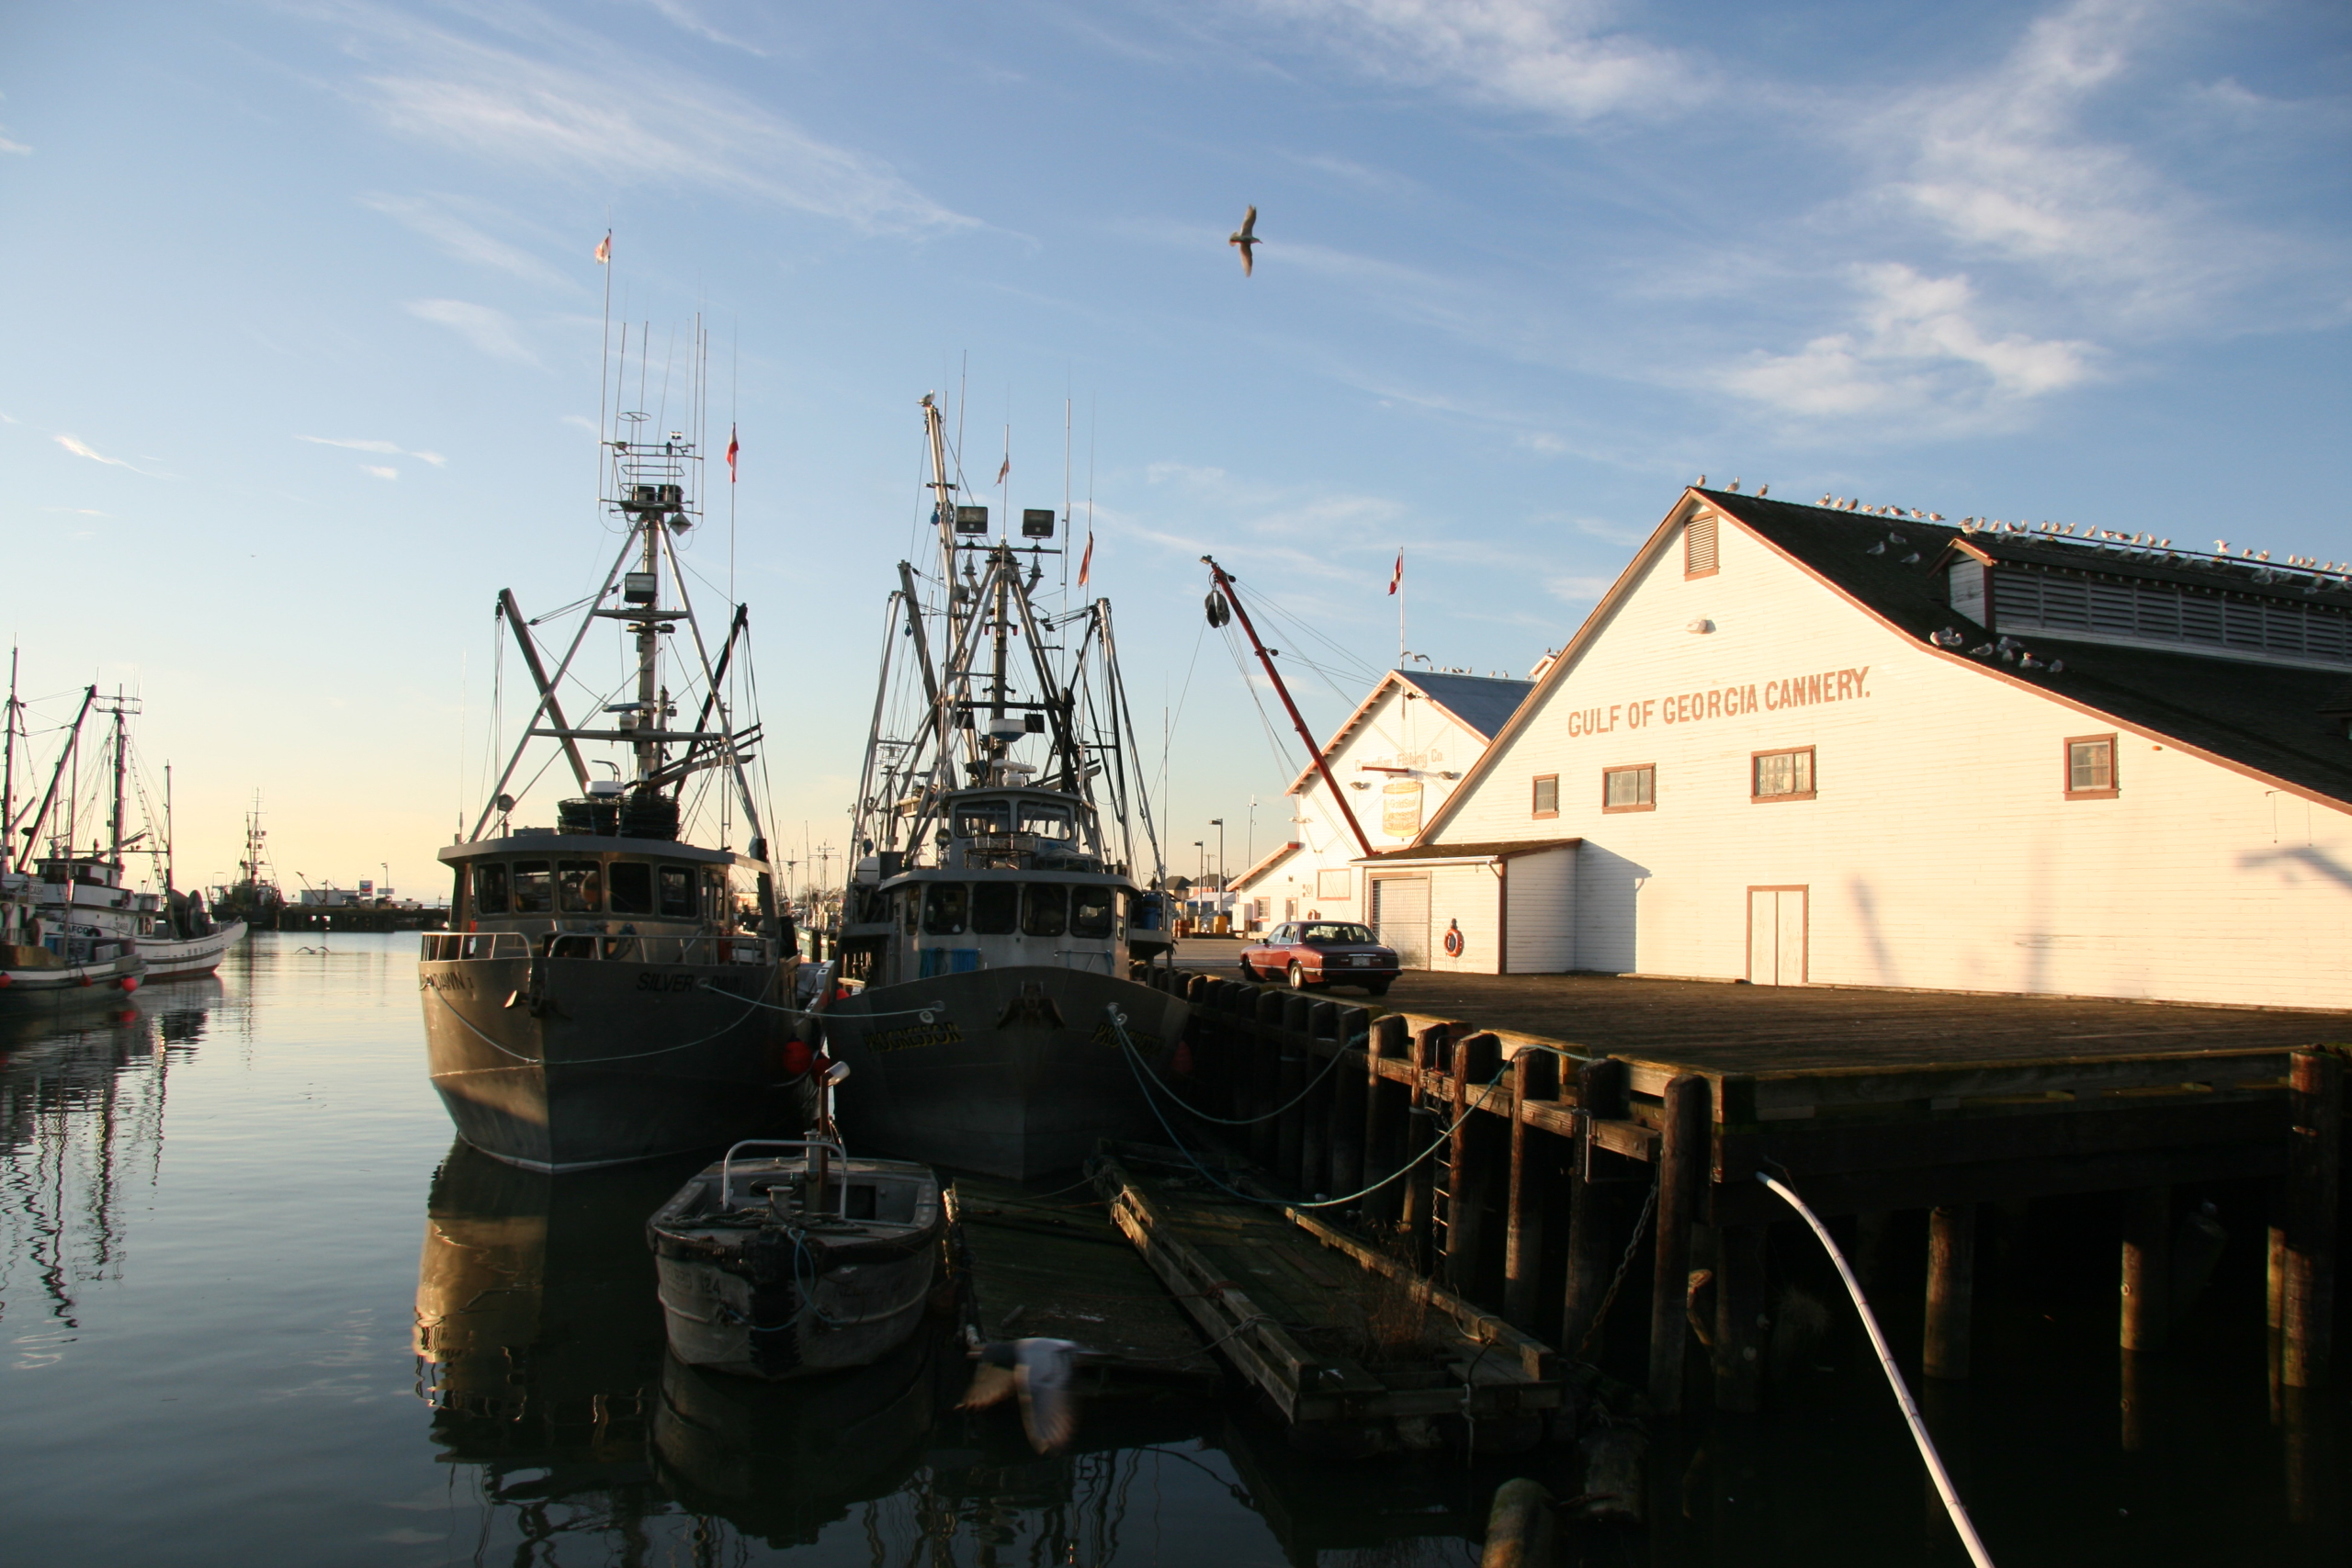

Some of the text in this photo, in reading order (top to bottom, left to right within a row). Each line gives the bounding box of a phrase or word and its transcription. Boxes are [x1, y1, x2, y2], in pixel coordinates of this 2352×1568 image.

[1568, 666, 1871, 738] GULF OF GEORGIA CANNERY.
[1397, 751, 1428, 768] Fishing
[1431, 749, 1444, 762] Co.
[637, 972, 695, 992] SILVER
[701, 1275, 720, 1295] 124
